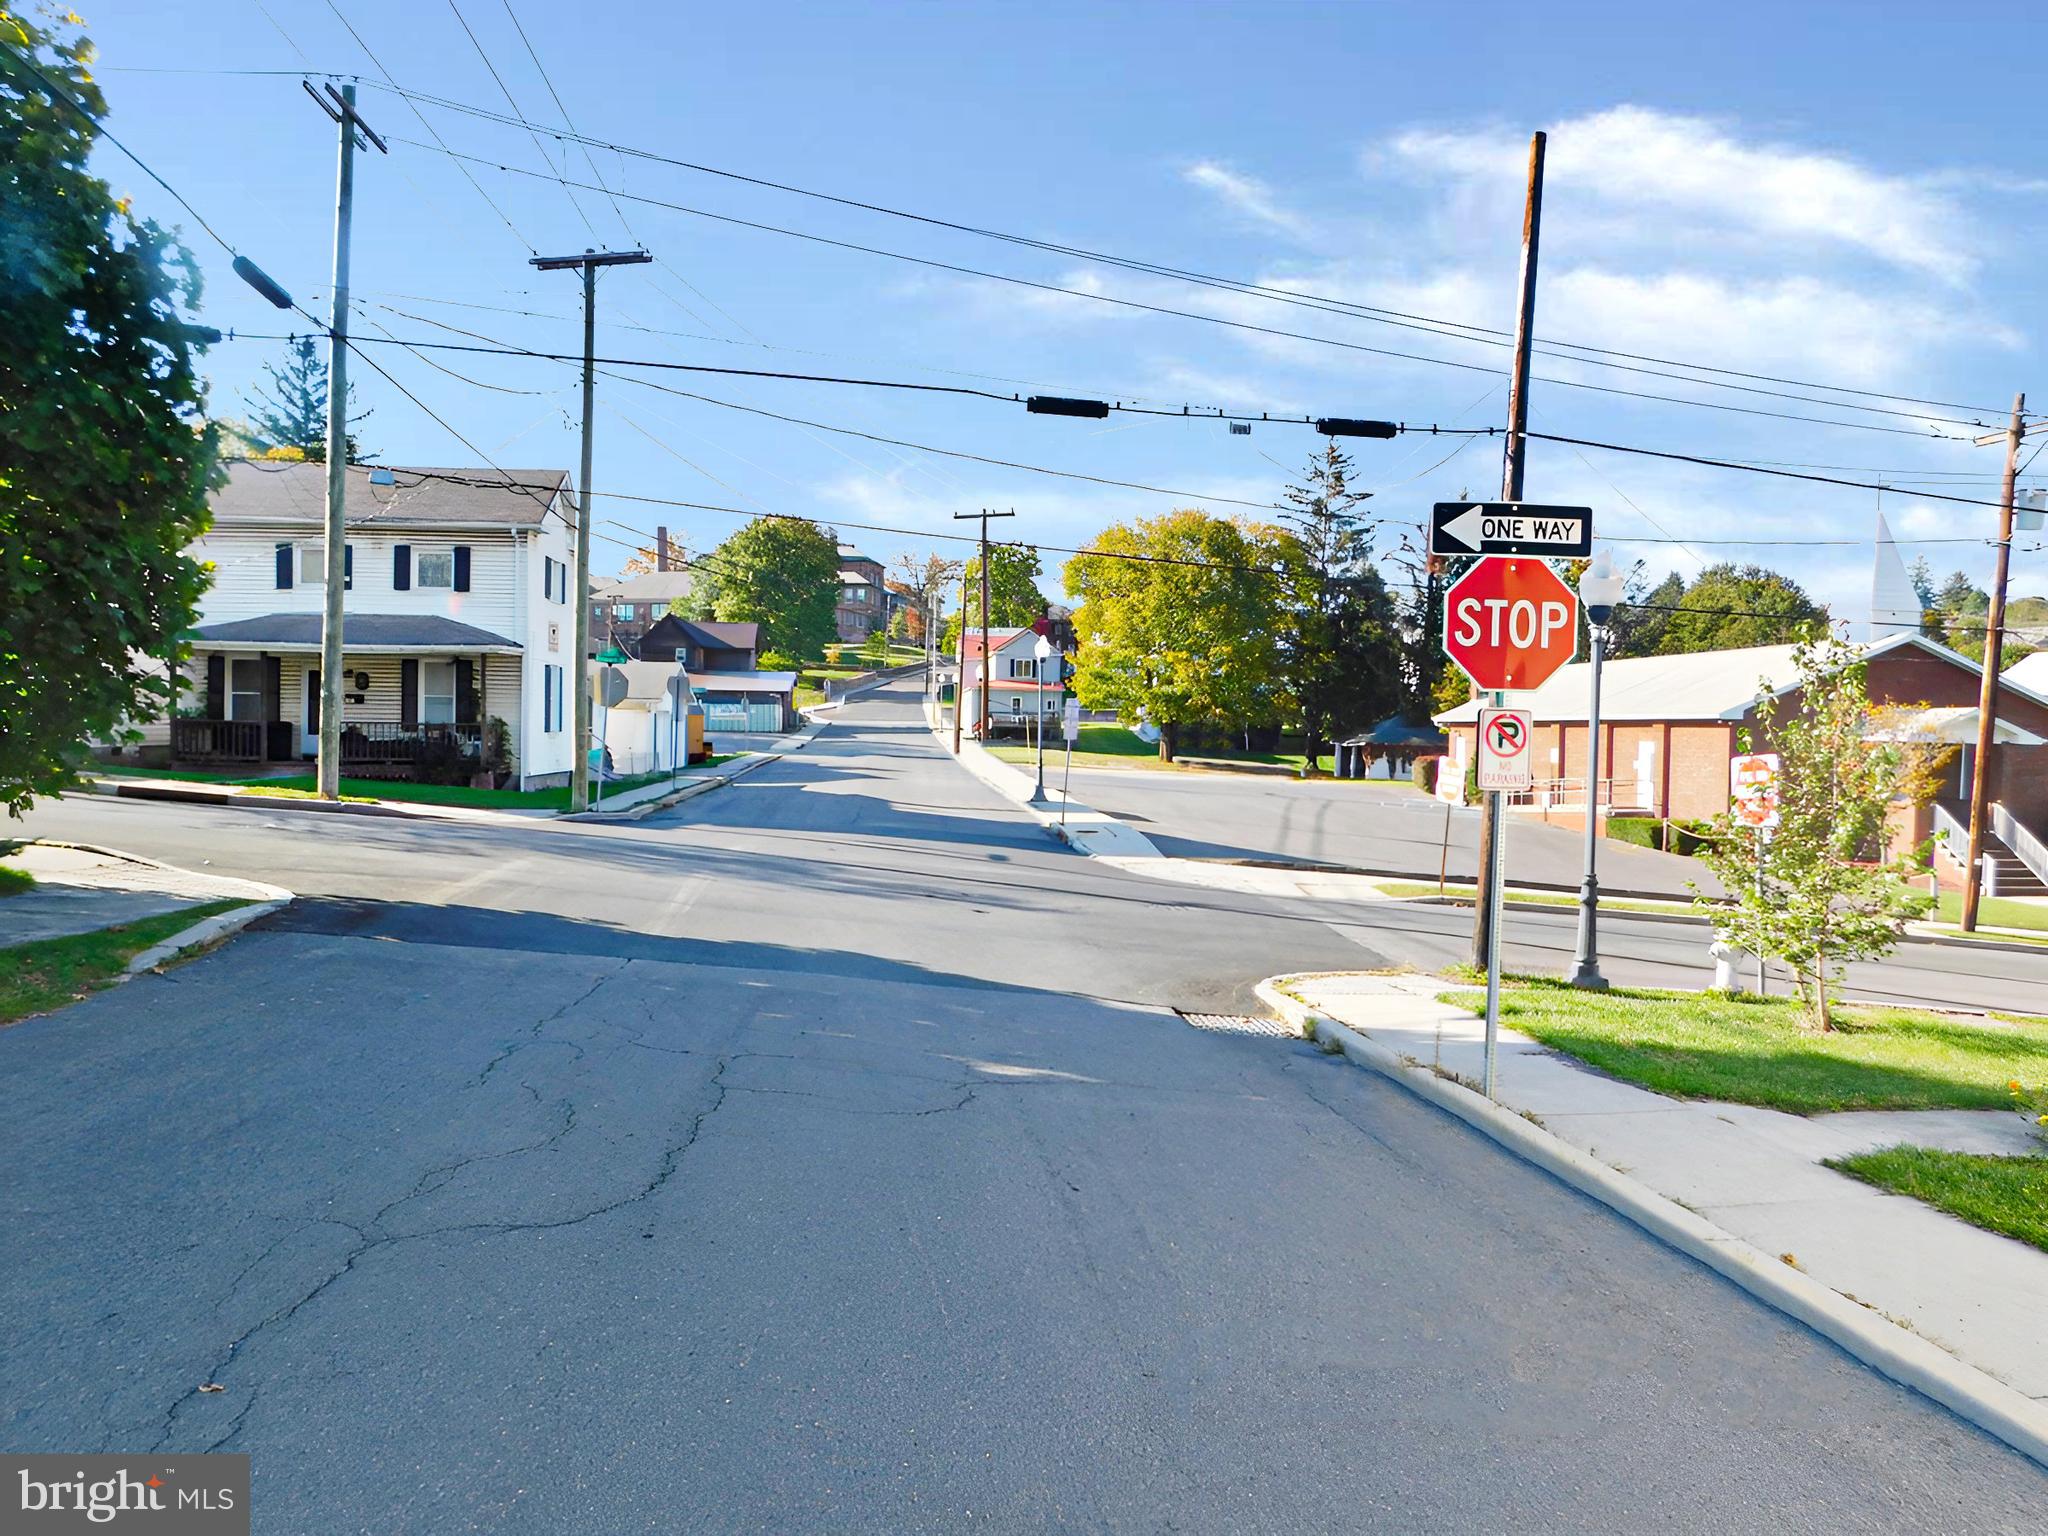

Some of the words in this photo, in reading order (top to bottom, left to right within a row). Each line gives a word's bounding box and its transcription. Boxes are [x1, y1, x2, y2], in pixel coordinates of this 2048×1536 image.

[1482, 518, 1524, 539] ONE
[1533, 520, 1575, 541] WAY
[1454, 597, 1569, 649] STOP
